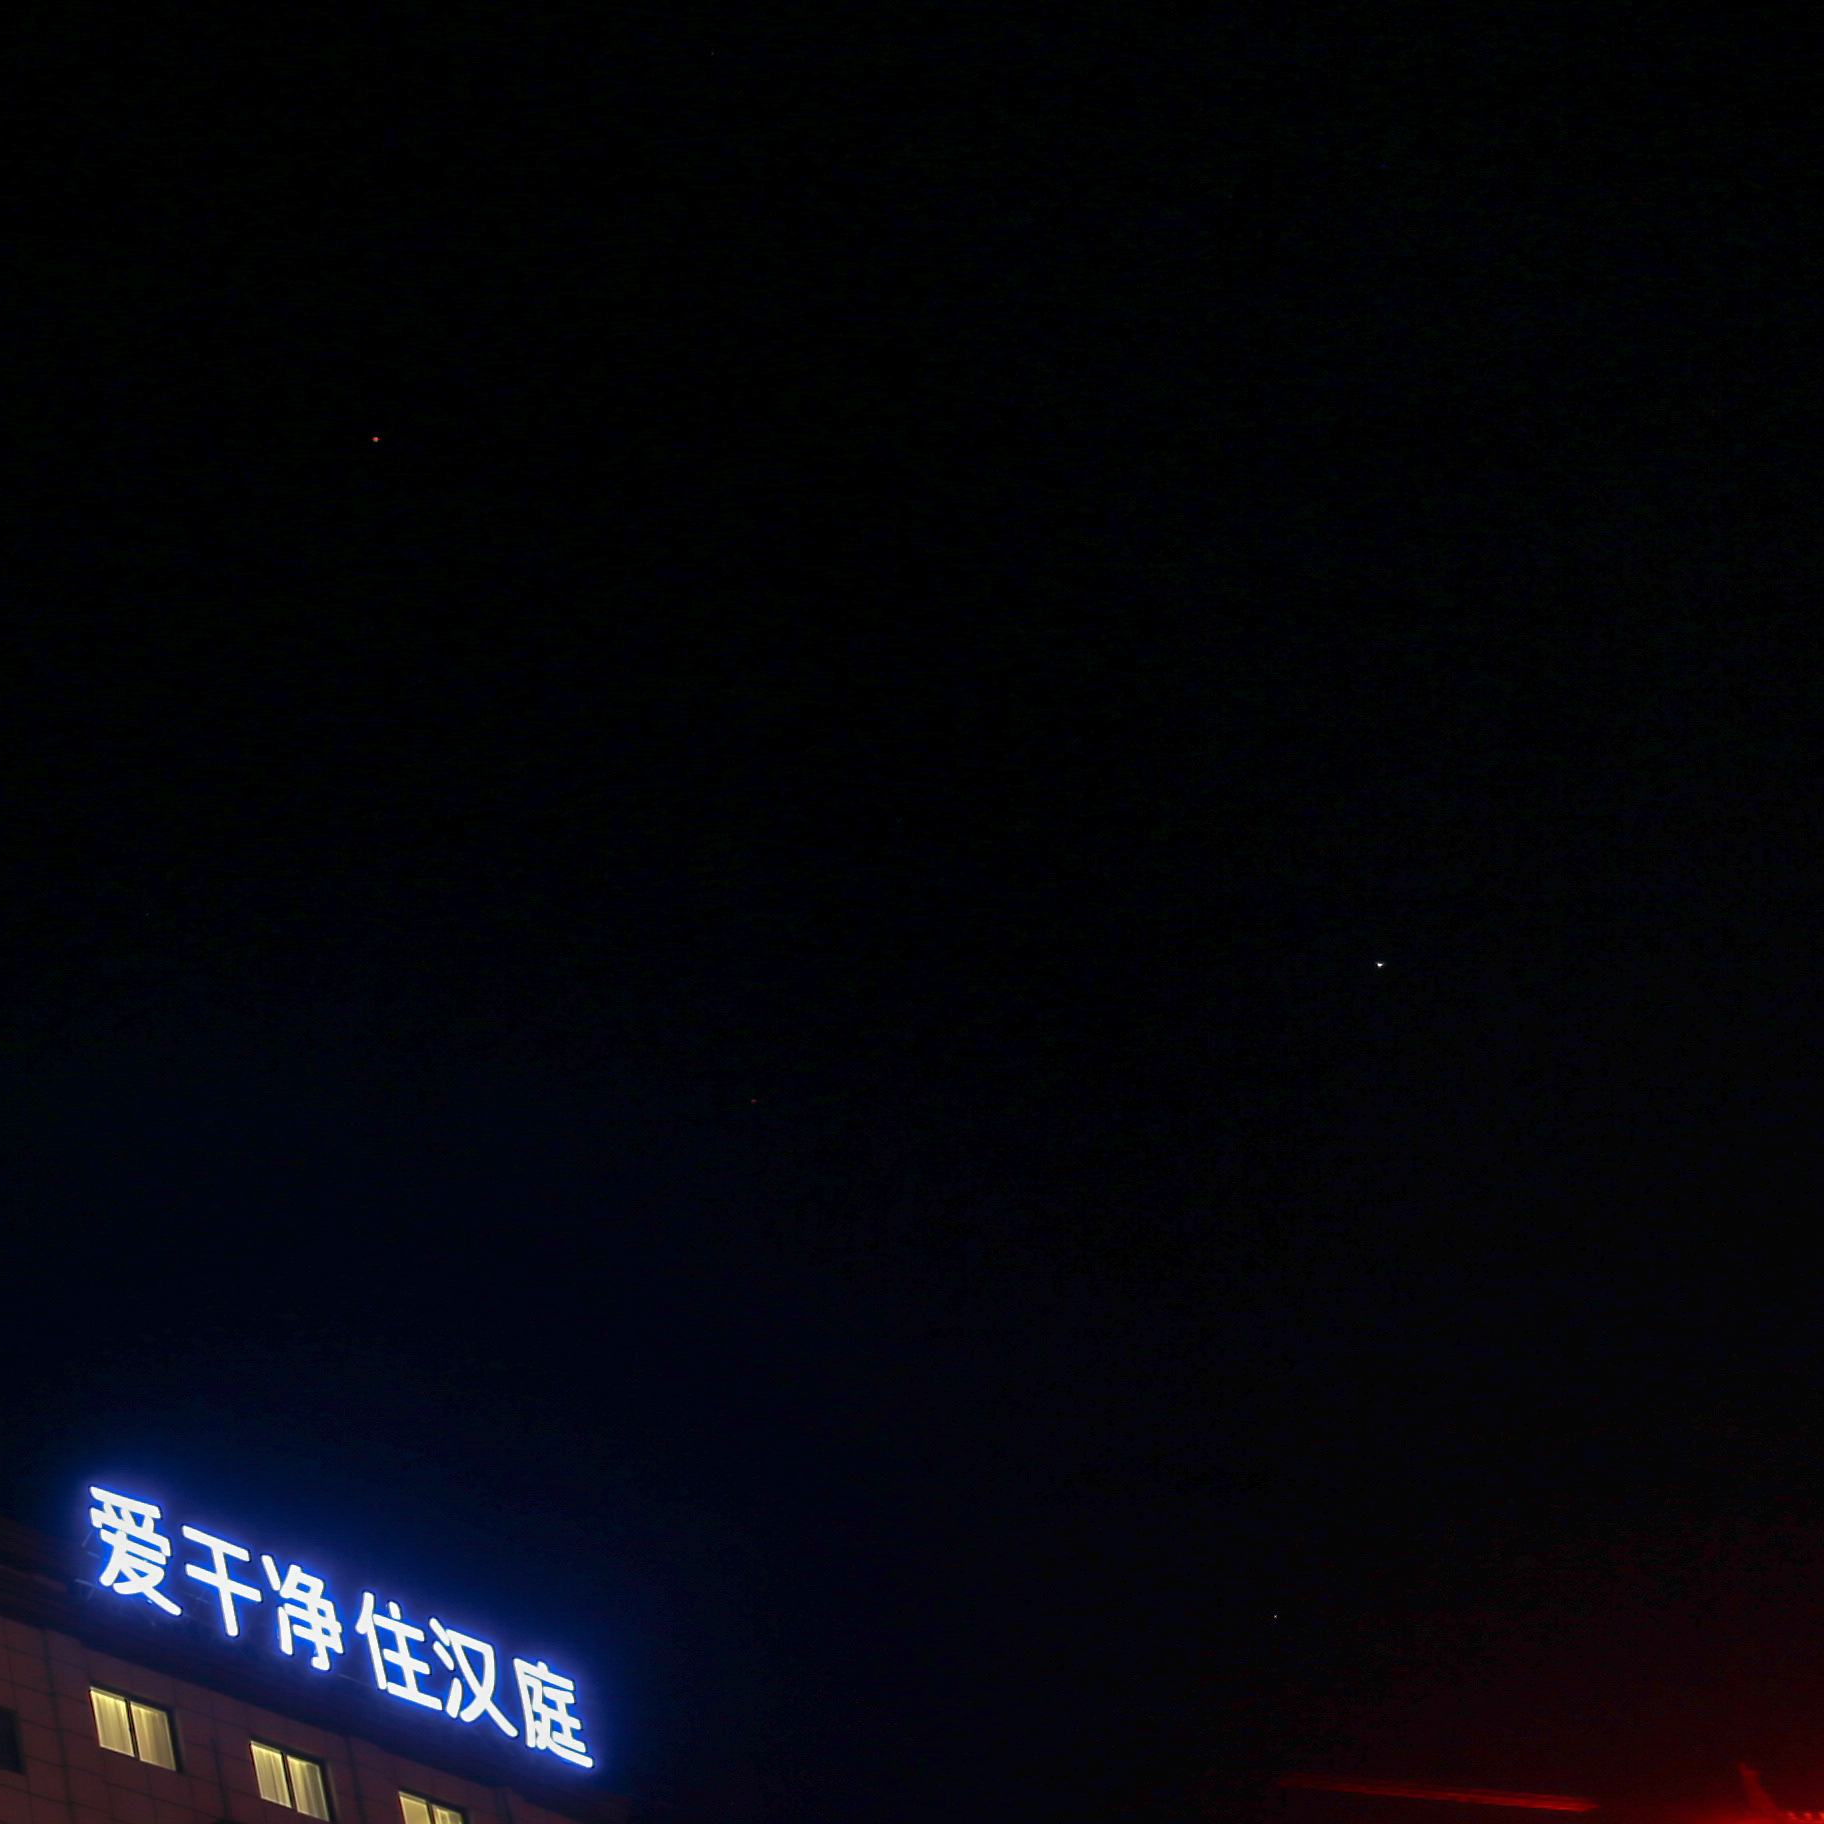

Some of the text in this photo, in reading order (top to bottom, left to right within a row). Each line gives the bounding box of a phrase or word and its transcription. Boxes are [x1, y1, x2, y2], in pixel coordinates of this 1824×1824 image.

[88, 1486, 595, 1768] 爱干净住汉庭
